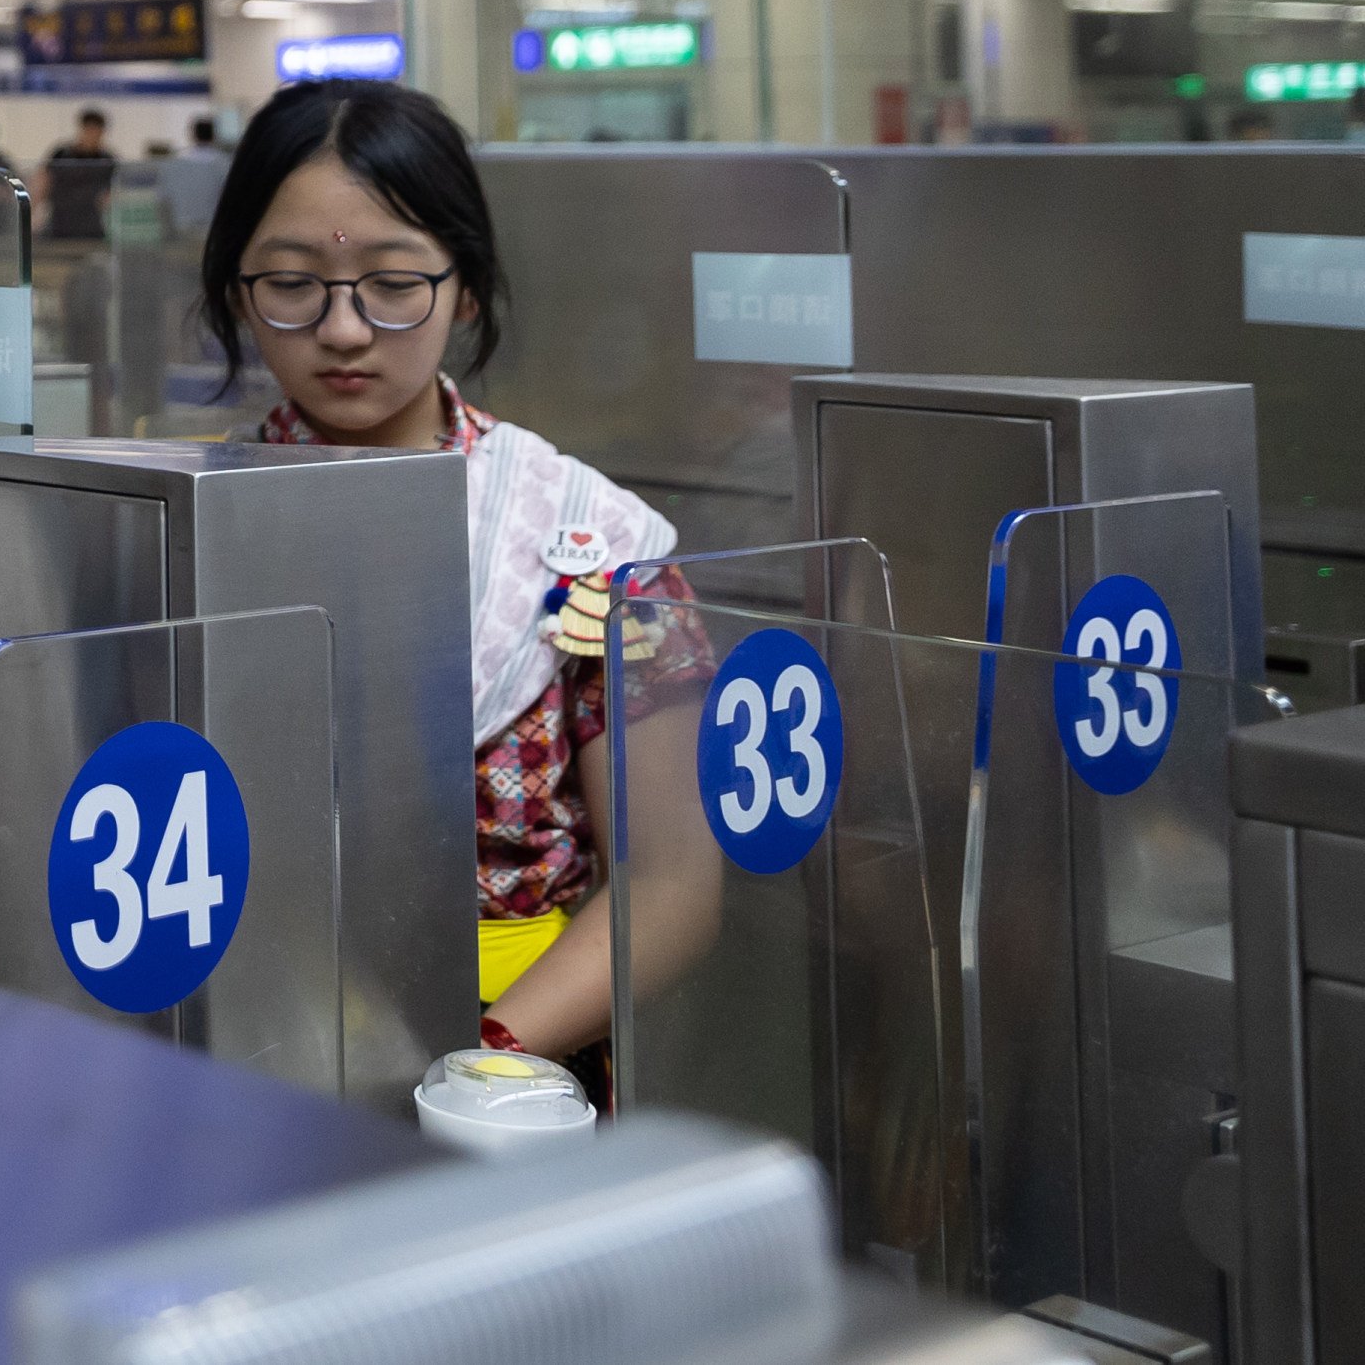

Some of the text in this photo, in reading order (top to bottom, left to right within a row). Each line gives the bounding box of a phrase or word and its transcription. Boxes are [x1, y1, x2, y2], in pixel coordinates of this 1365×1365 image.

[546, 545, 603, 562] KIRAT
[556, 529, 566, 546] I
[715, 663, 827, 835] 33
[1074, 608, 1168, 758] 33
[68, 769, 225, 971] 34
